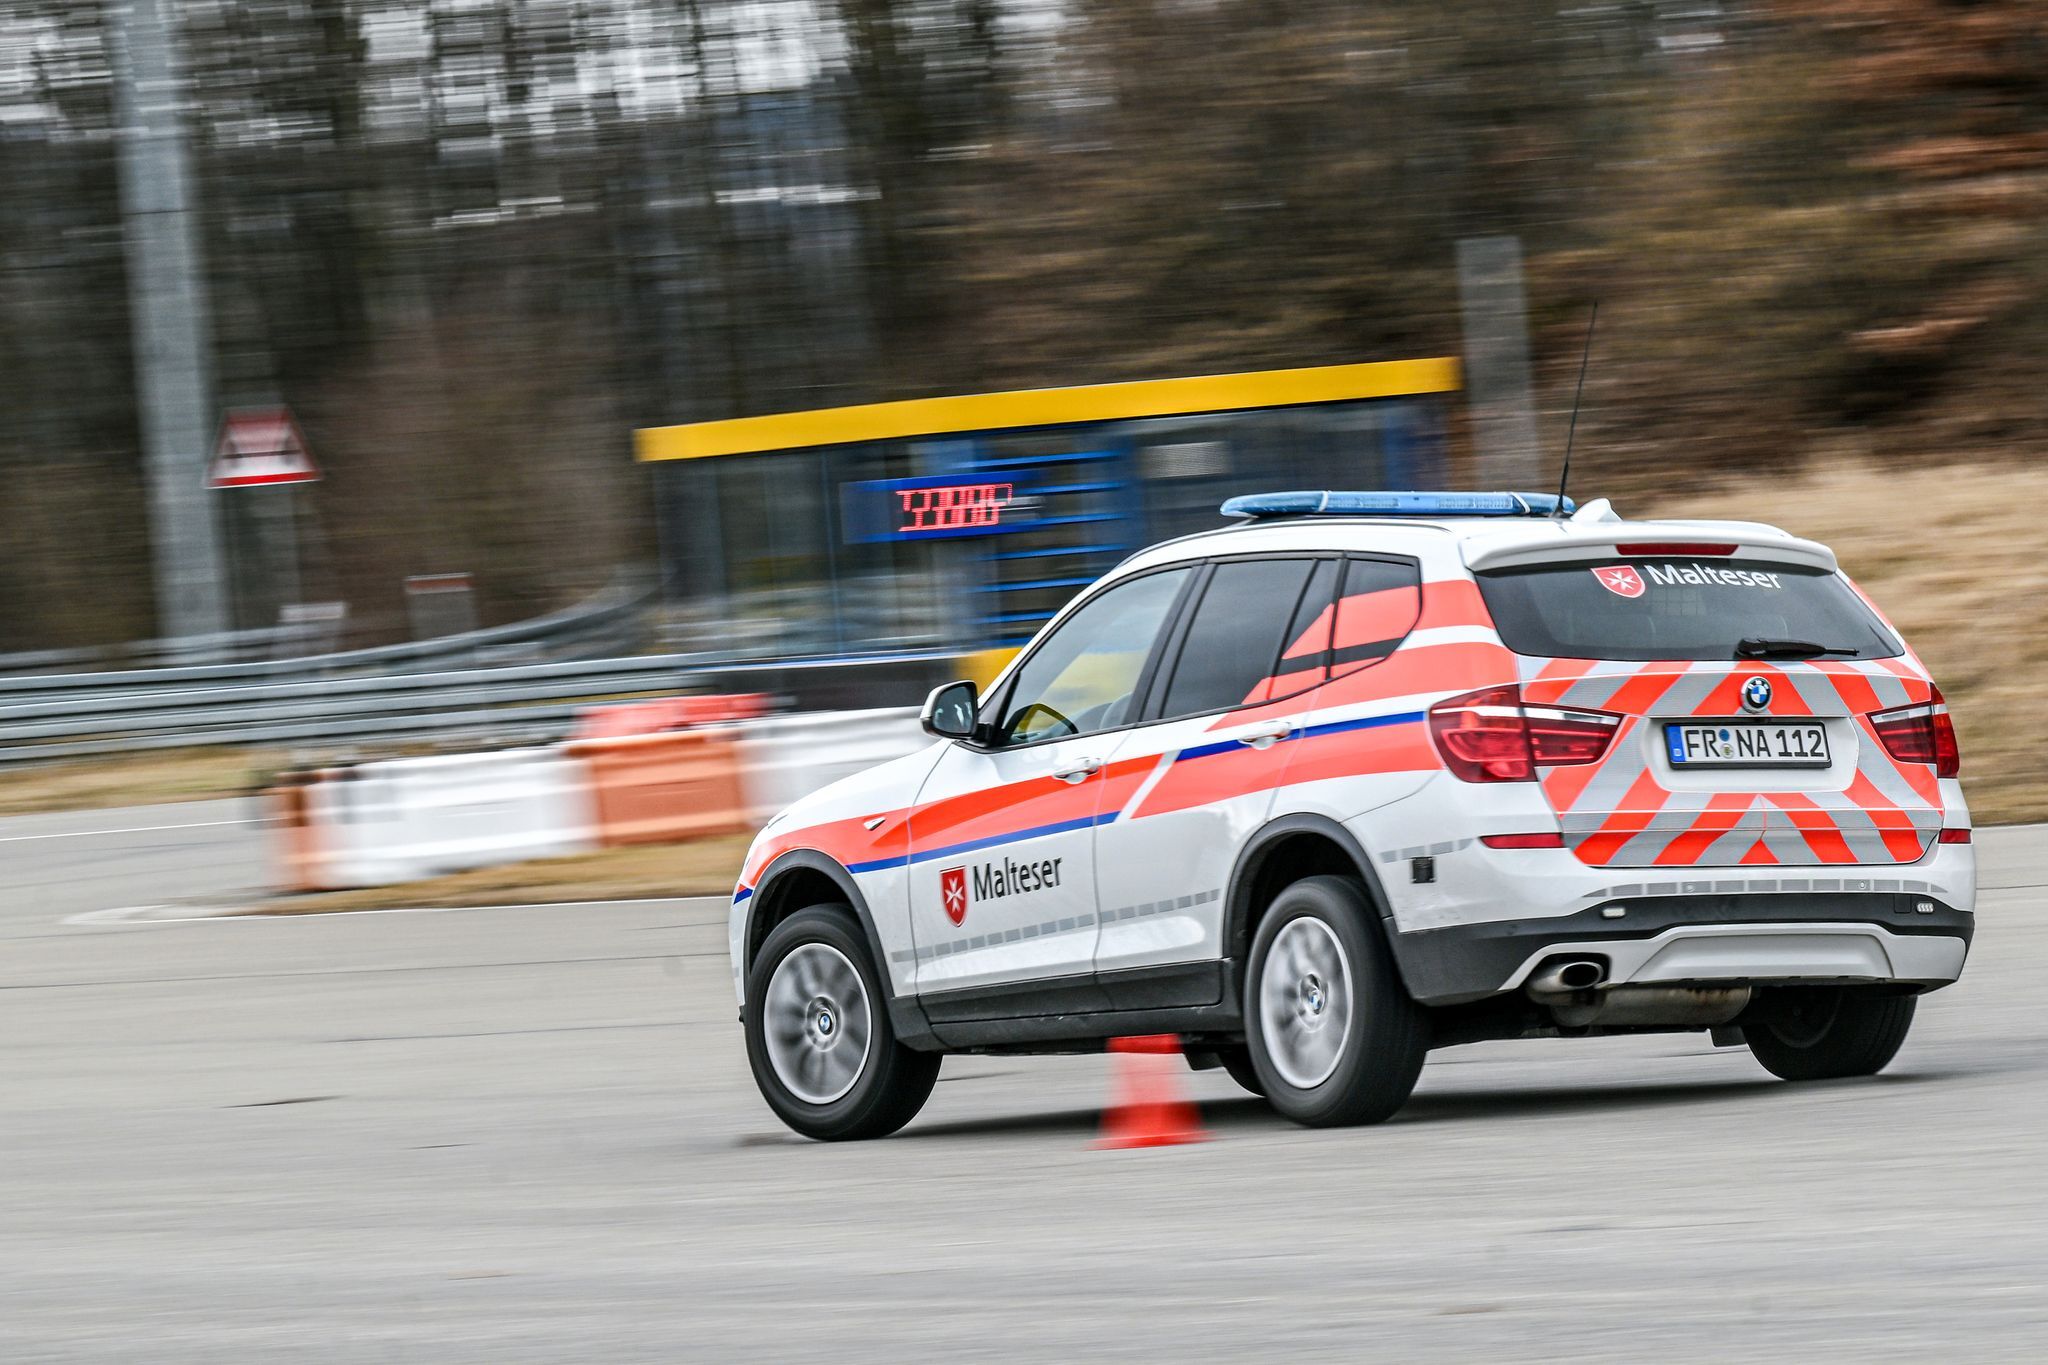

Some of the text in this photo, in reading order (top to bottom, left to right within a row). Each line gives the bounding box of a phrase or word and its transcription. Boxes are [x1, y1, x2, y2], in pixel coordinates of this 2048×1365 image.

[1644, 563, 1782, 589] Malteser
[1685, 729, 1825, 758] FR NA 112
[973, 856, 1062, 902] Malteser
